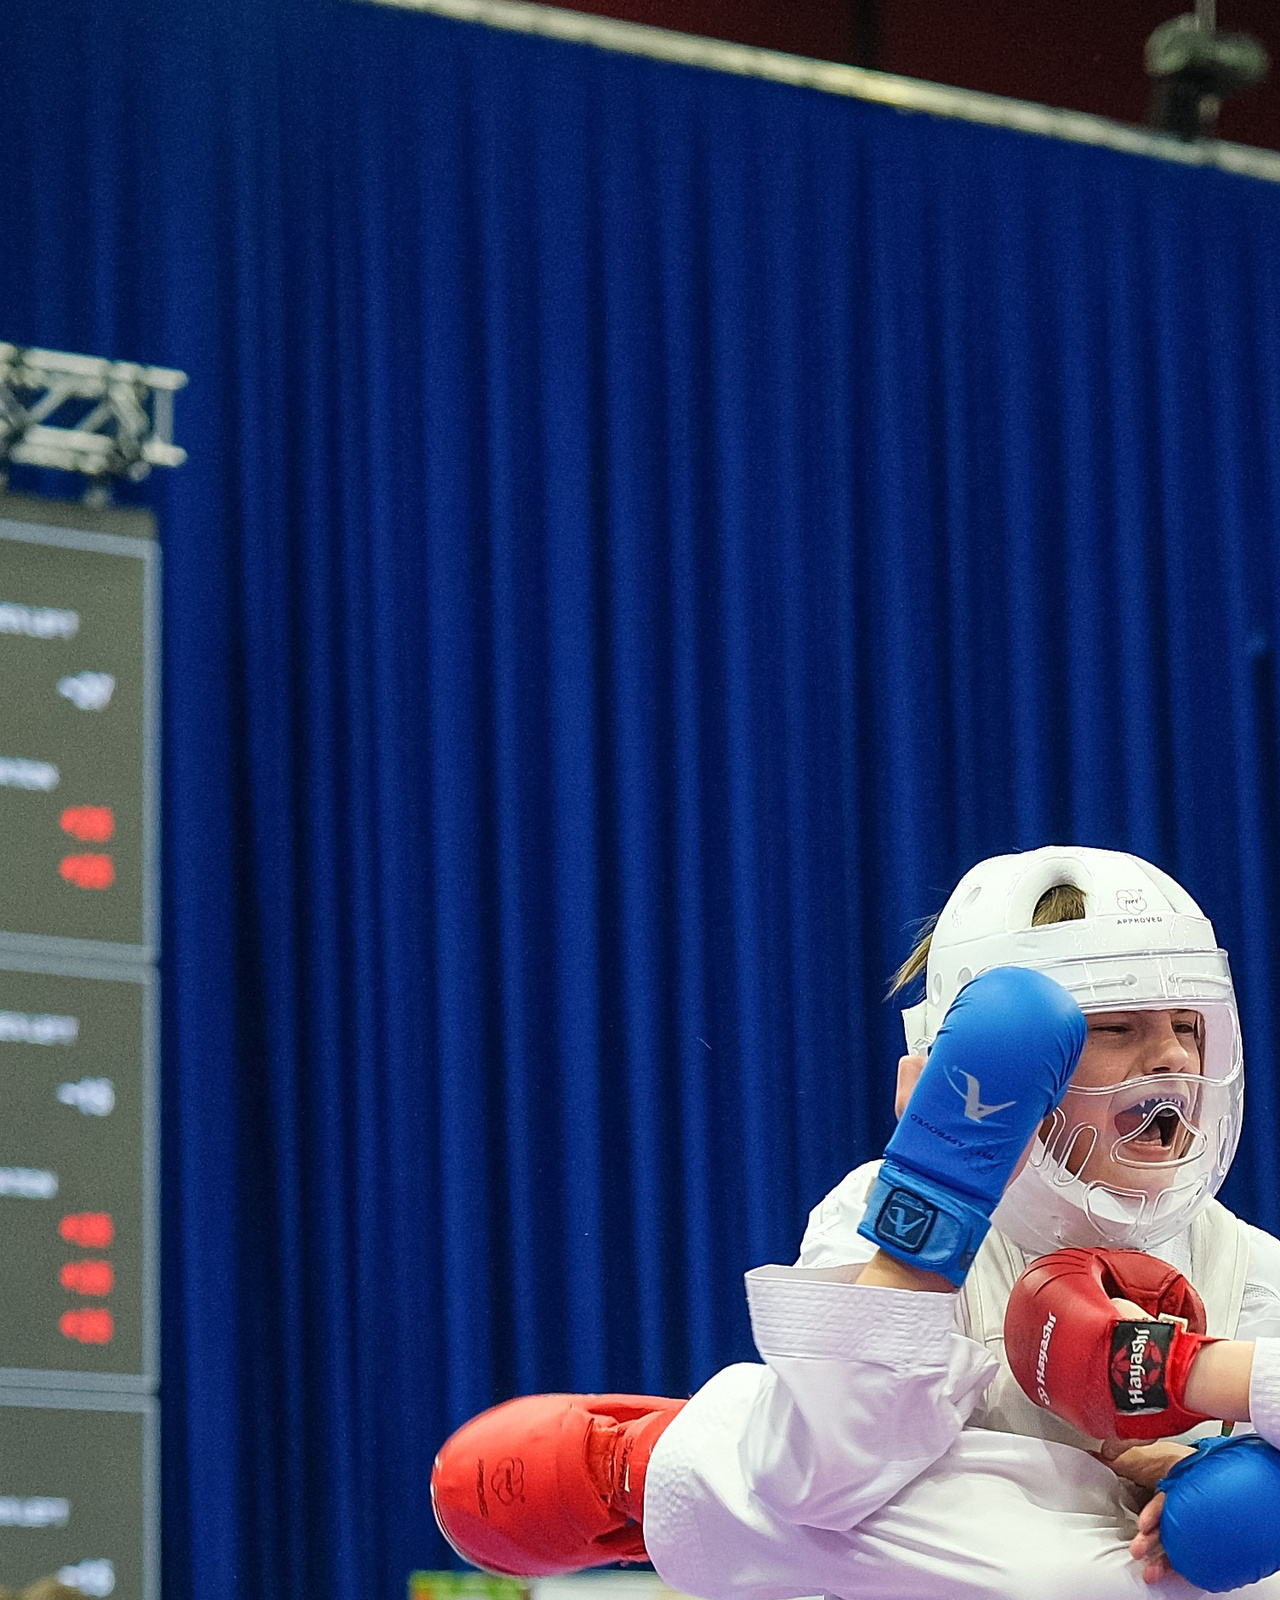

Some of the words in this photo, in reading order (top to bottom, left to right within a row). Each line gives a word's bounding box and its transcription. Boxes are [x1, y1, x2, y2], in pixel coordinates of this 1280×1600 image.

[1117, 916, 1163, 925] APPROVED
[1036, 1311, 1057, 1387] Hayashi
[1128, 1327, 1150, 1405] Hayashi
